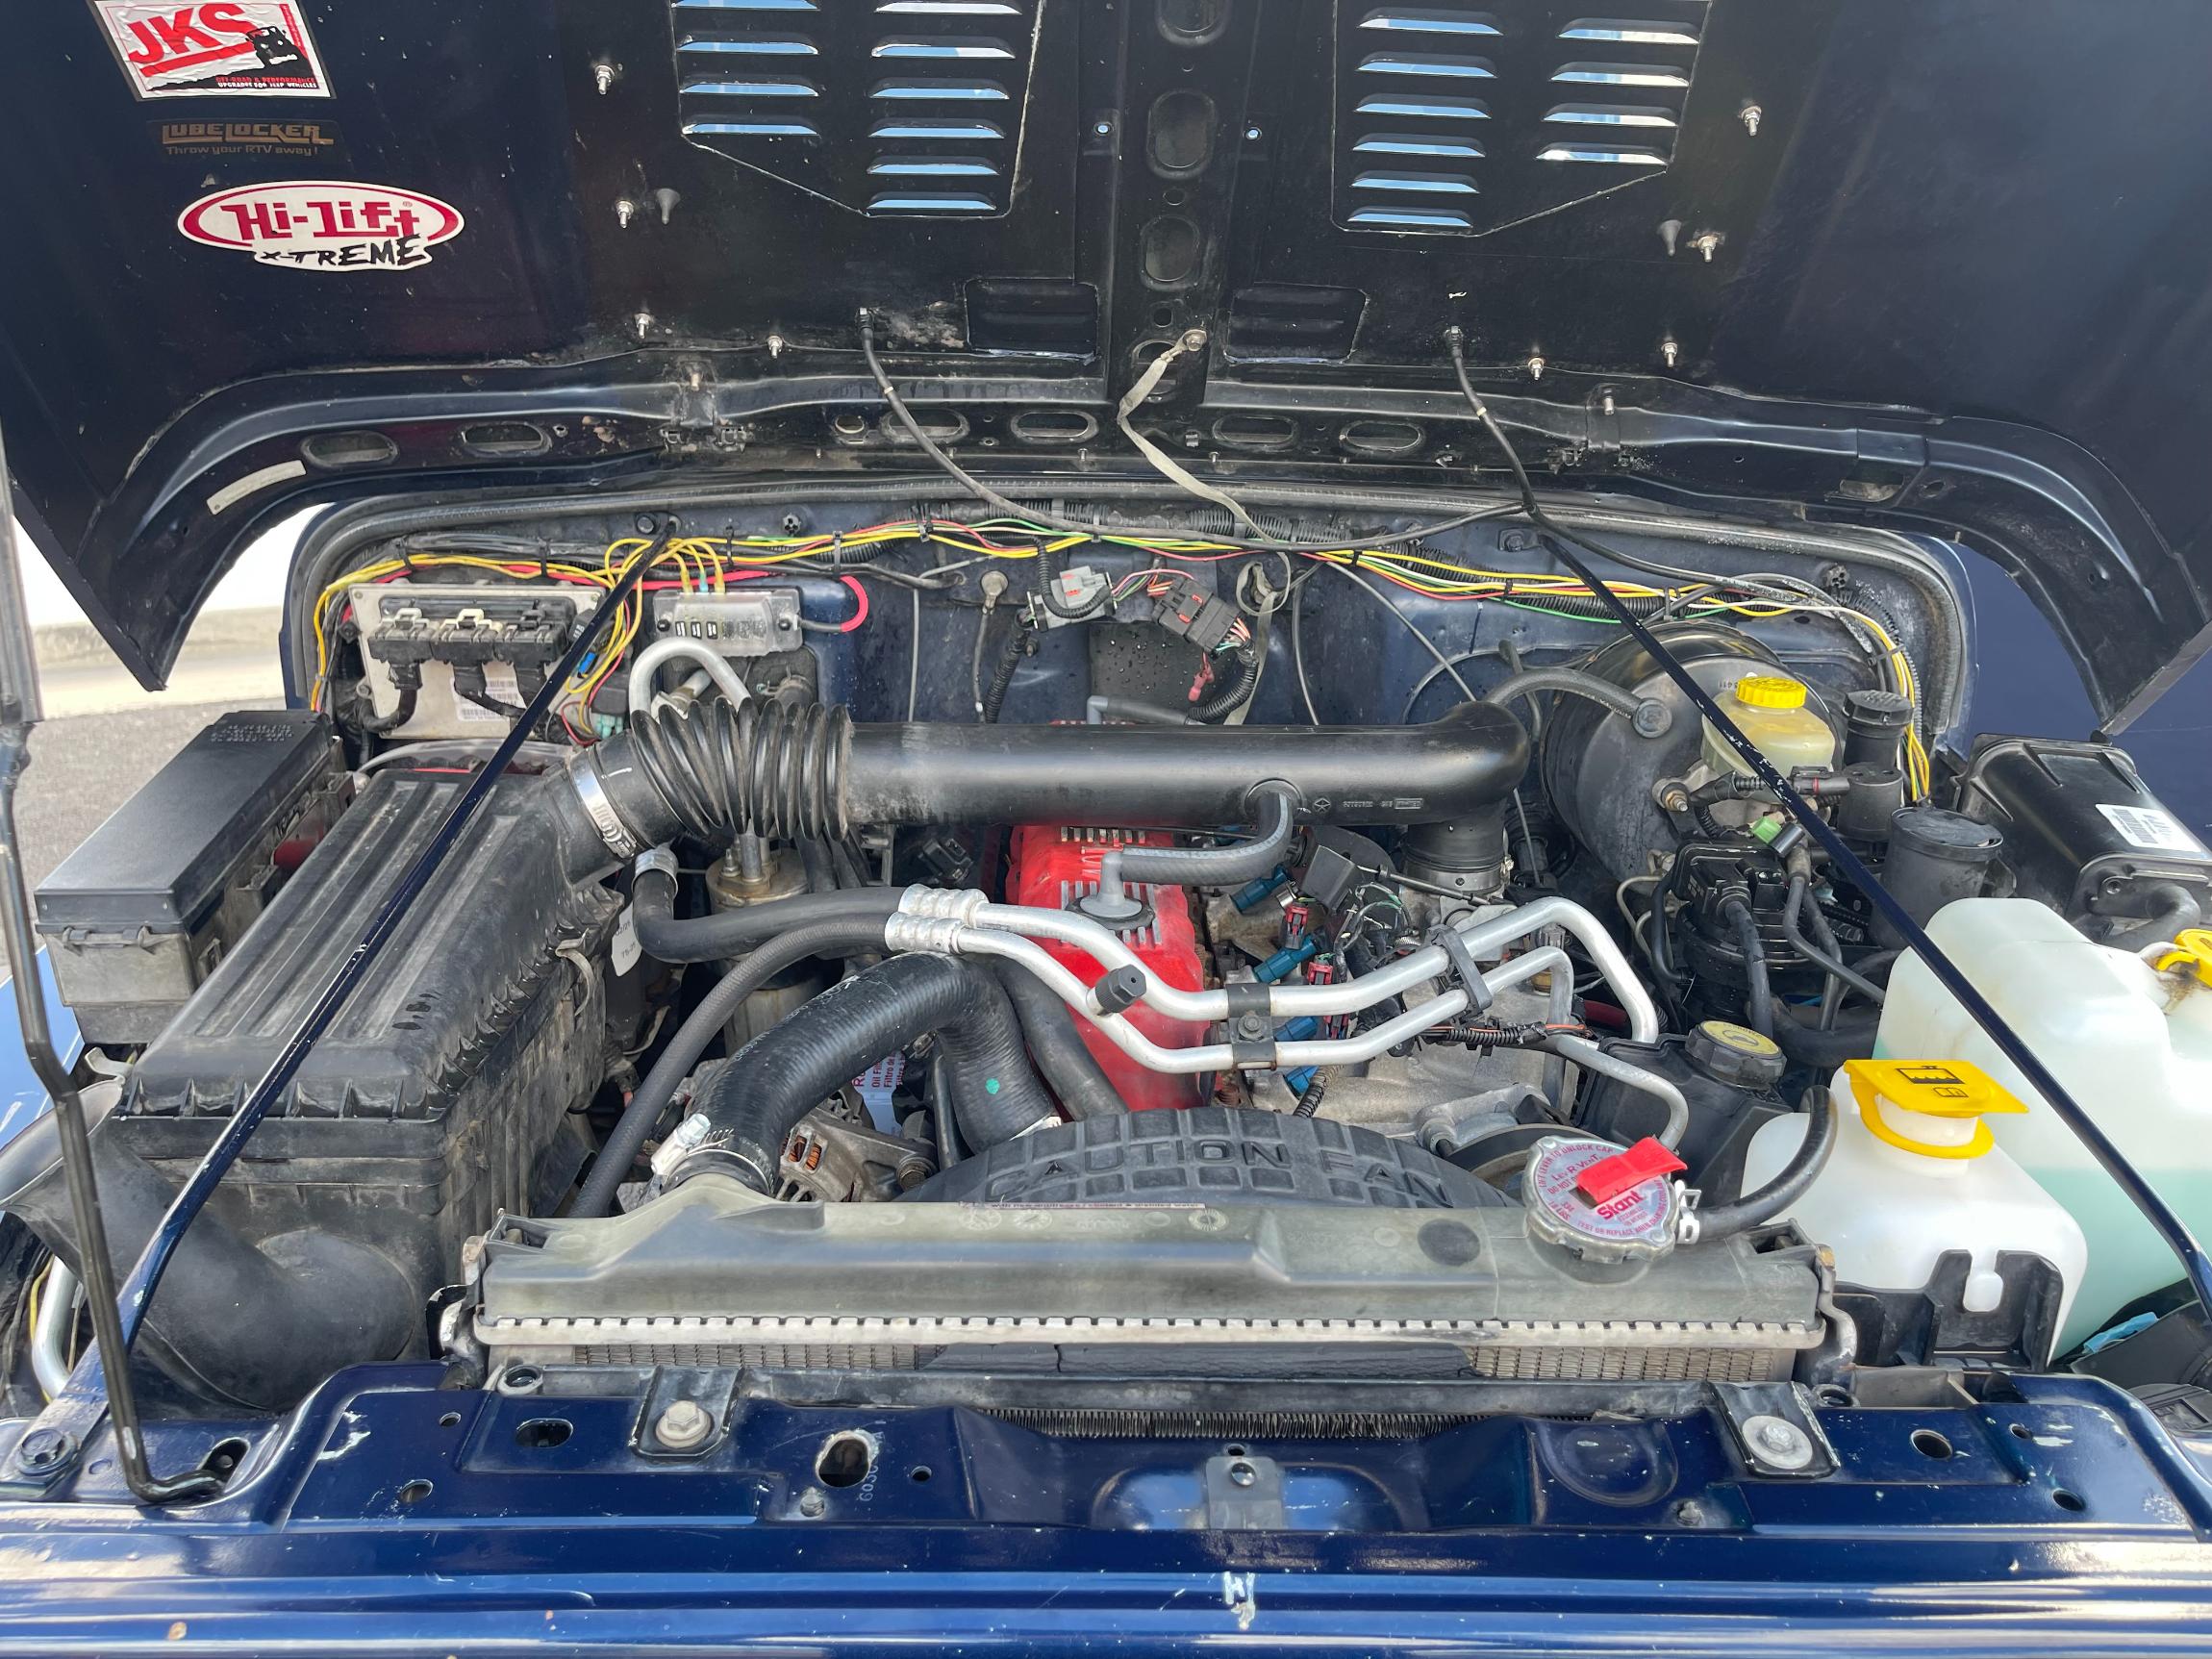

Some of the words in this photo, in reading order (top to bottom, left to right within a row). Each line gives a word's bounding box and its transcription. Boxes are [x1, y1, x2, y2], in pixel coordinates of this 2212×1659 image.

[127, 3, 259, 64] JKS
[166, 145, 209, 155] Throw
[212, 146, 241, 155] your
[245, 144, 273, 154] RTV
[260, 234, 427, 267] X-TREME
[871, 1076, 881, 1089] Oil
[883, 1067, 894, 1089] Filtro
[1550, 1149, 1562, 1159] TO
[1561, 1144, 1594, 1154] UNLOCK
[1596, 1144, 1614, 1153] CAP
[985, 1138, 1292, 1201] CAUTION
[1318, 1148, 1453, 1208] FAN
[1596, 1190, 1645, 1220] Stant
[1577, 1219, 1594, 1232] TEST
